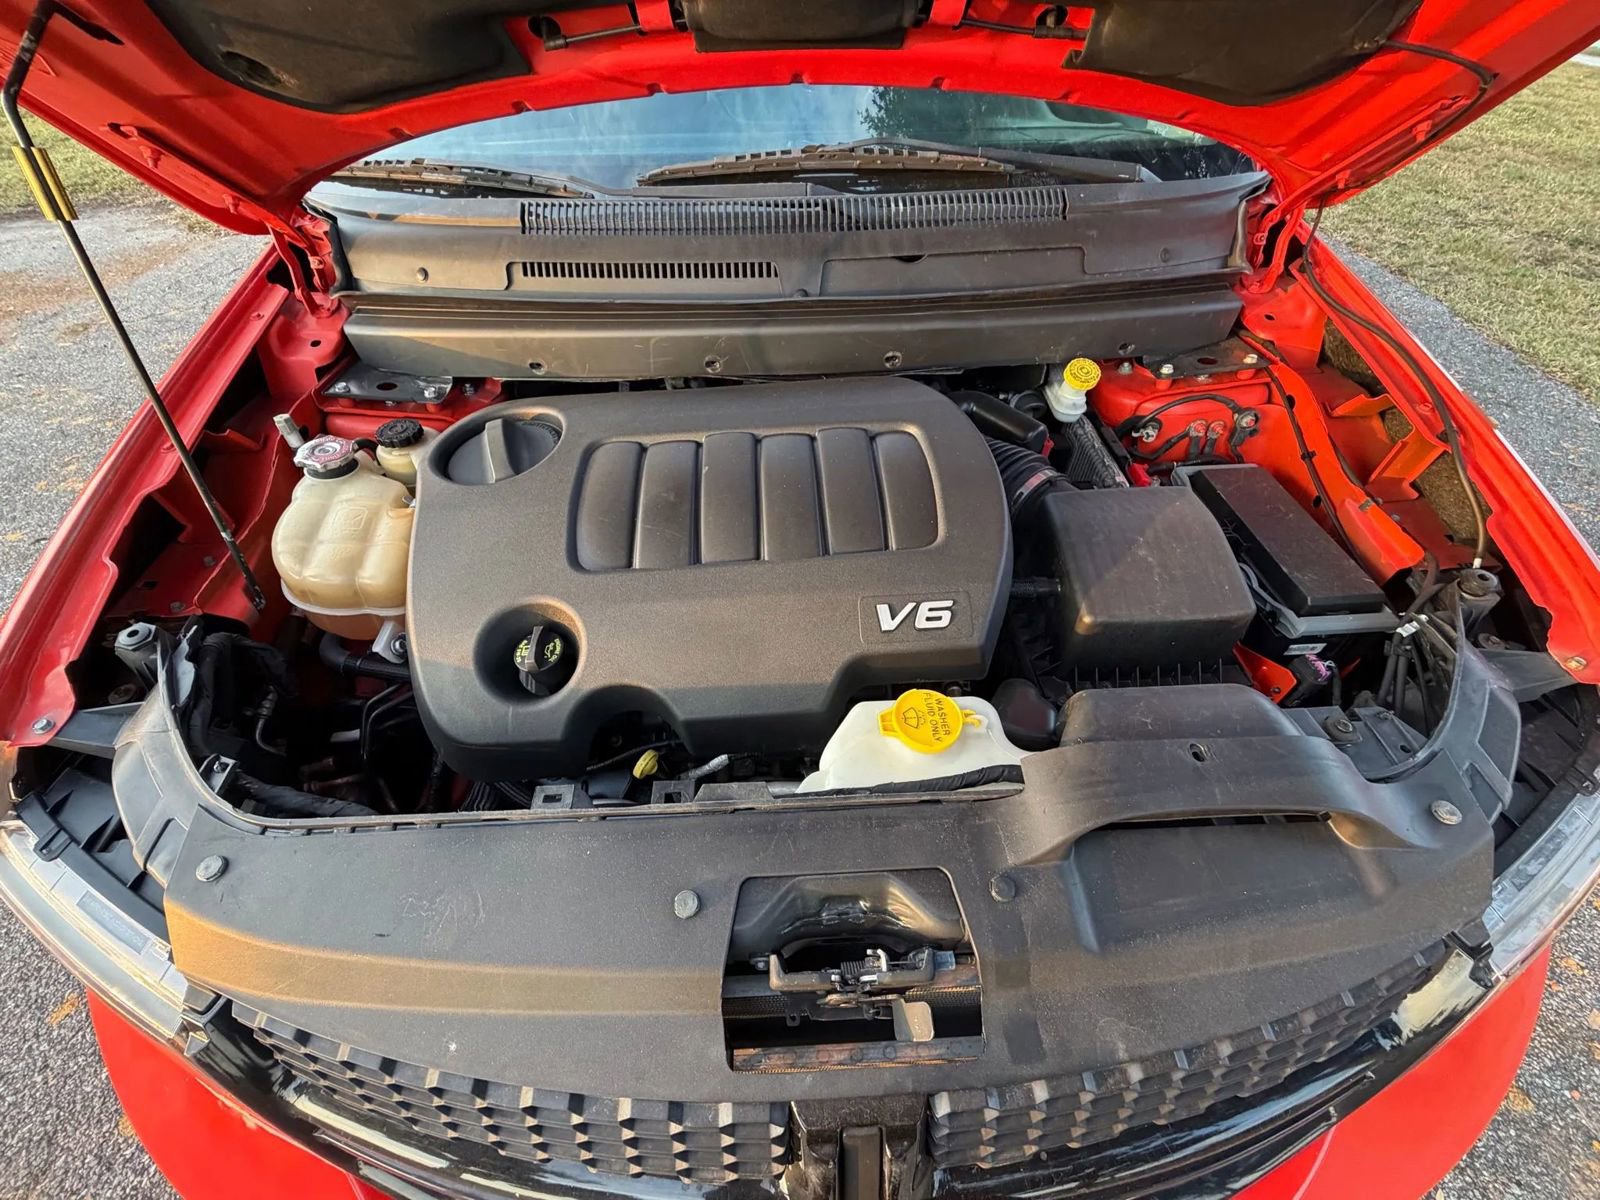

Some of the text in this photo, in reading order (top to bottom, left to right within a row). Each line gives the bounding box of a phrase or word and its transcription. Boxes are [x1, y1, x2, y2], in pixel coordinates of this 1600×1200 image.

[875, 599, 956, 632] V6
[922, 692, 943, 743] FLUID ONLY
[934, 697, 951, 736] WASHER
